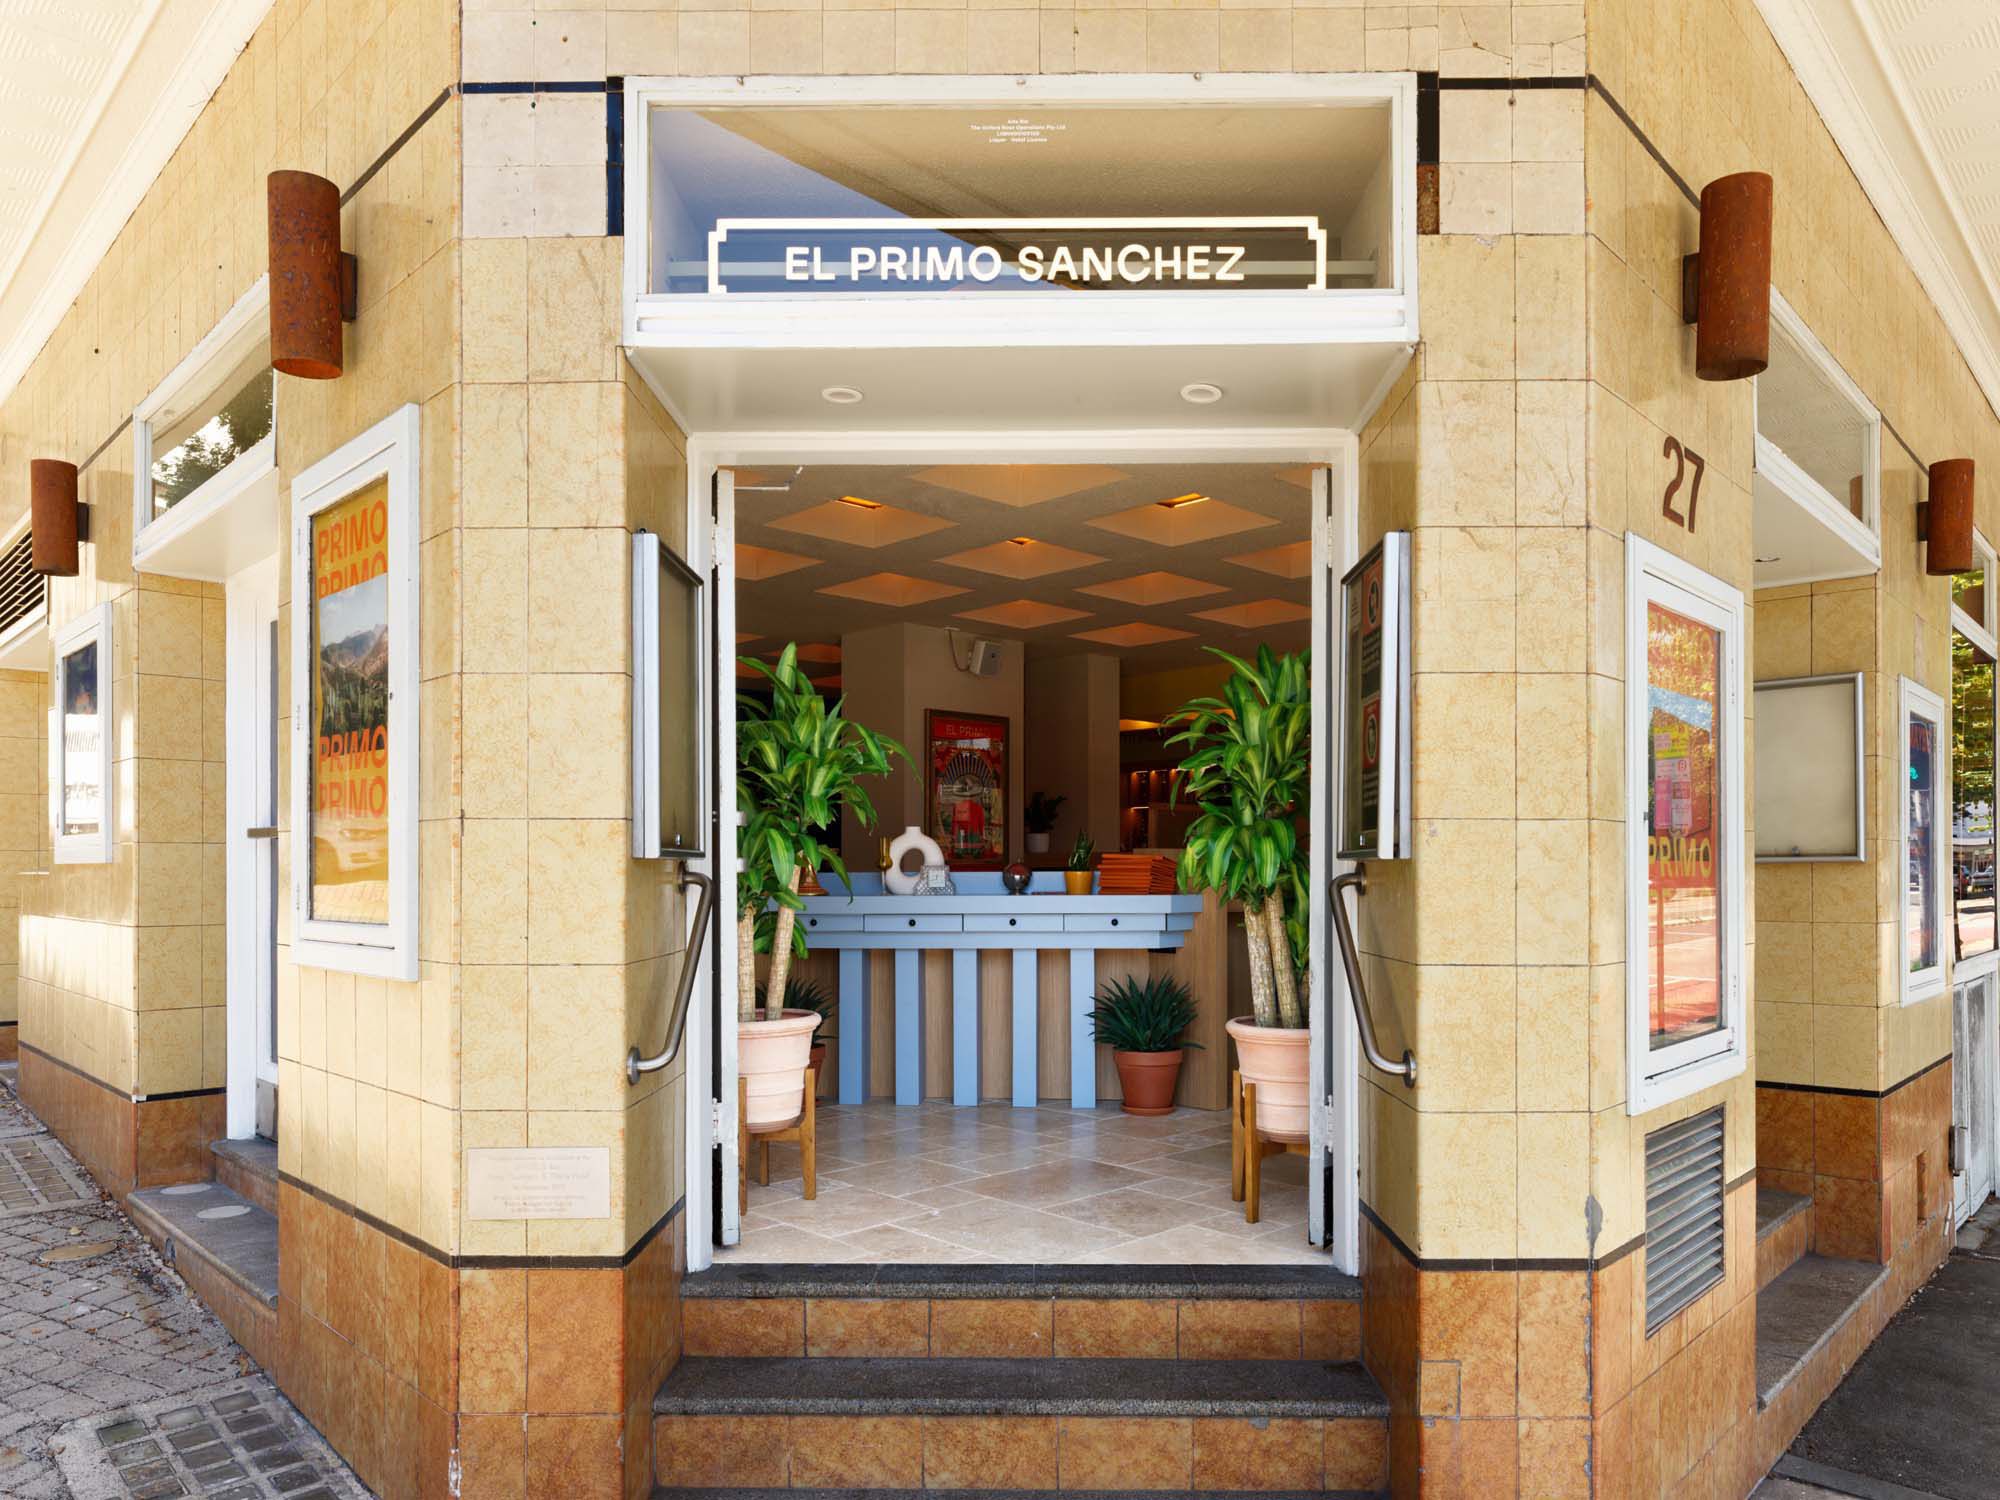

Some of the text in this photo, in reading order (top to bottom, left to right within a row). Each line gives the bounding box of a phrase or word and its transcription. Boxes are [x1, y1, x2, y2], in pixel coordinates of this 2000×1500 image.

[785, 244, 1244, 281] EL PRIMO SANCHEZ
[1662, 435, 1705, 534] 27
[319, 499, 386, 568] PRIMO
[319, 725, 387, 774] PRIMO
[319, 776, 387, 818] PRIMO
[1648, 835, 1712, 878] PRIMO
